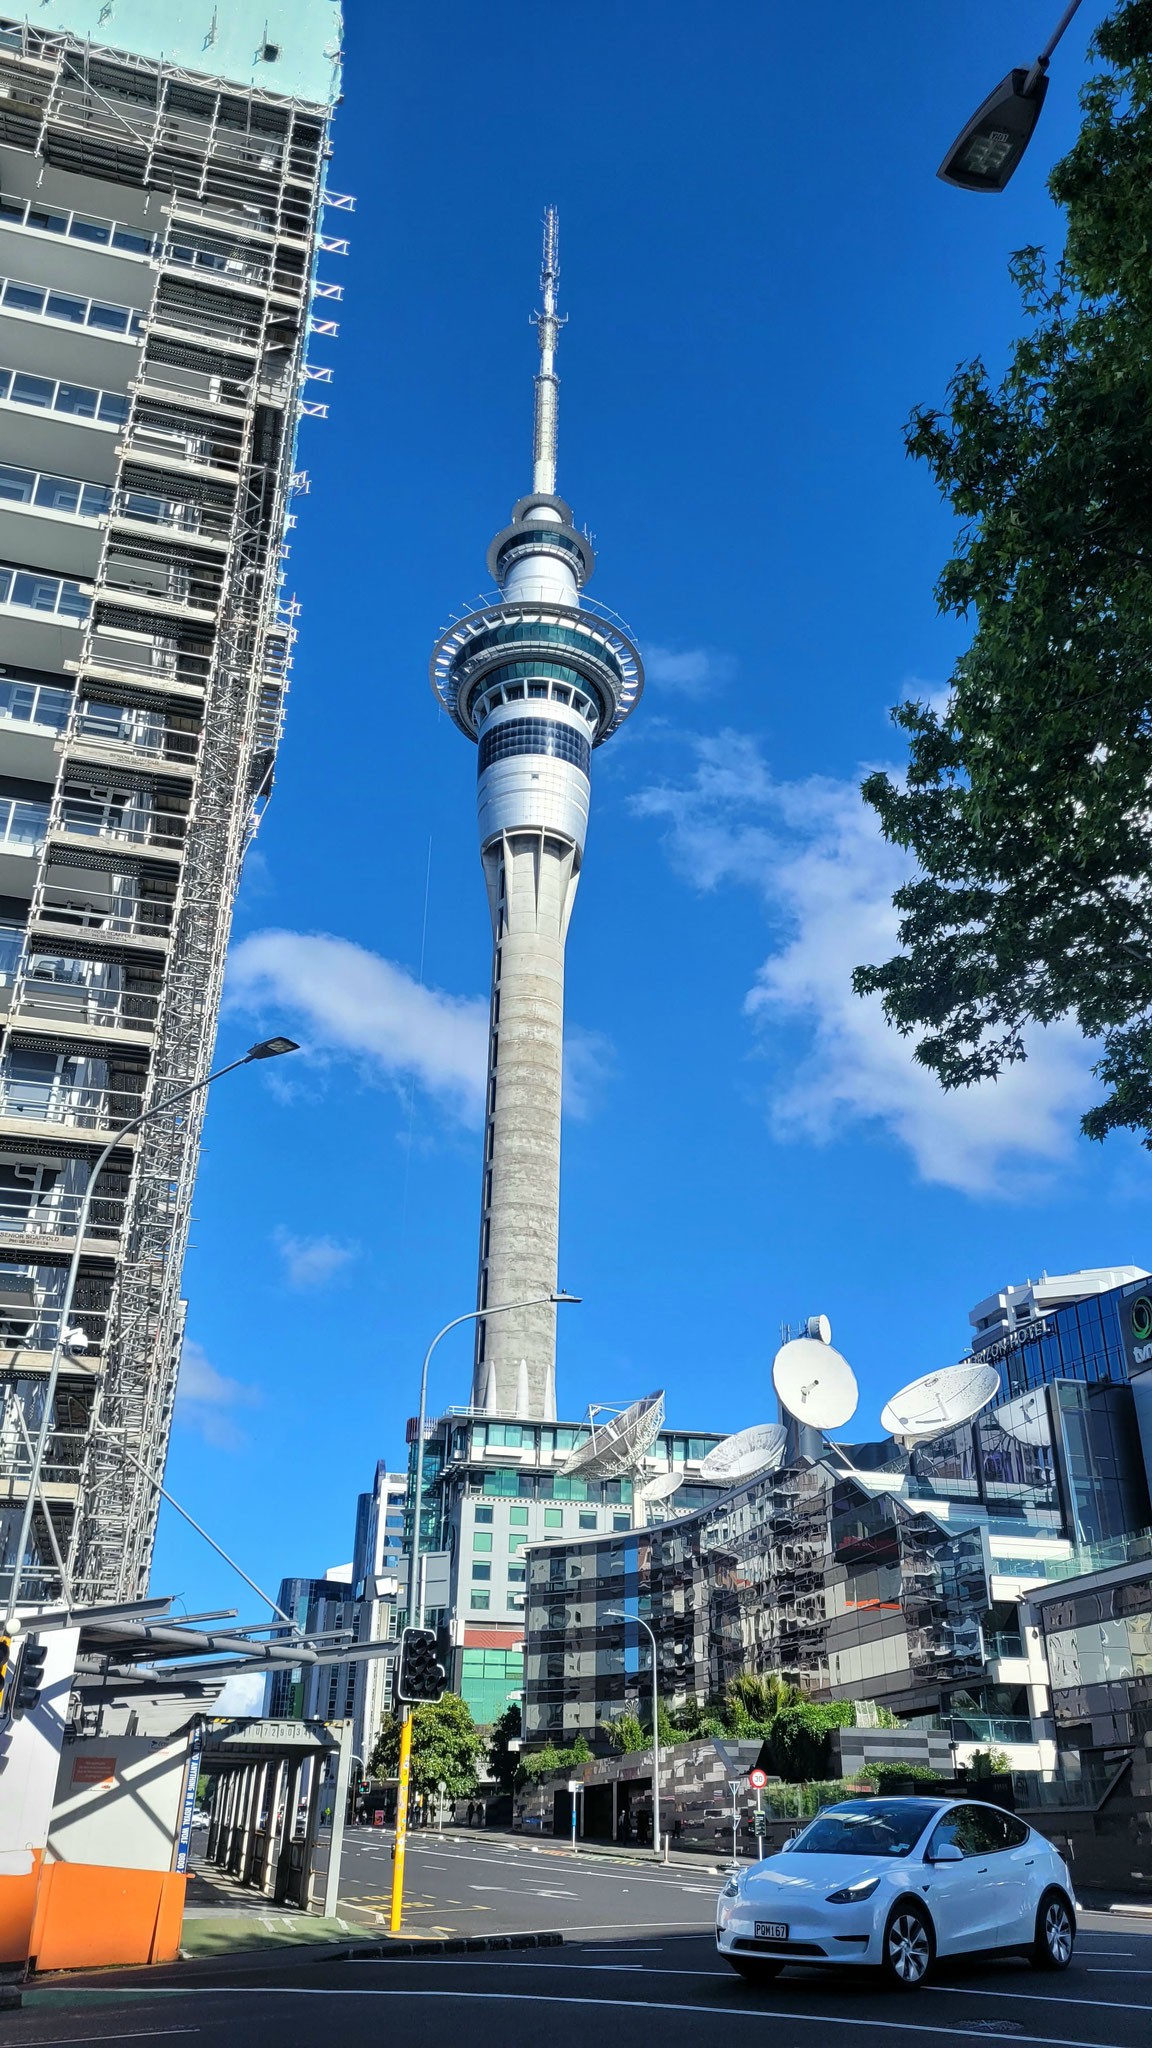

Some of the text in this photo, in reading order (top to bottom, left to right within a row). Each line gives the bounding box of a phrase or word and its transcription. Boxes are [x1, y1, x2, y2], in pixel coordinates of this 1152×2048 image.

[26, 1234, 59, 1242] SCAFFOLD
[1009, 1319, 1051, 1349] HOTEL
[188, 1762, 198, 1791] ANYTHING
[183, 1807, 192, 1826] ROYAL
[181, 1827, 190, 1845] WOLF
[177, 1852, 186, 1869] 0800
[756, 1924, 785, 1937] PQM167
